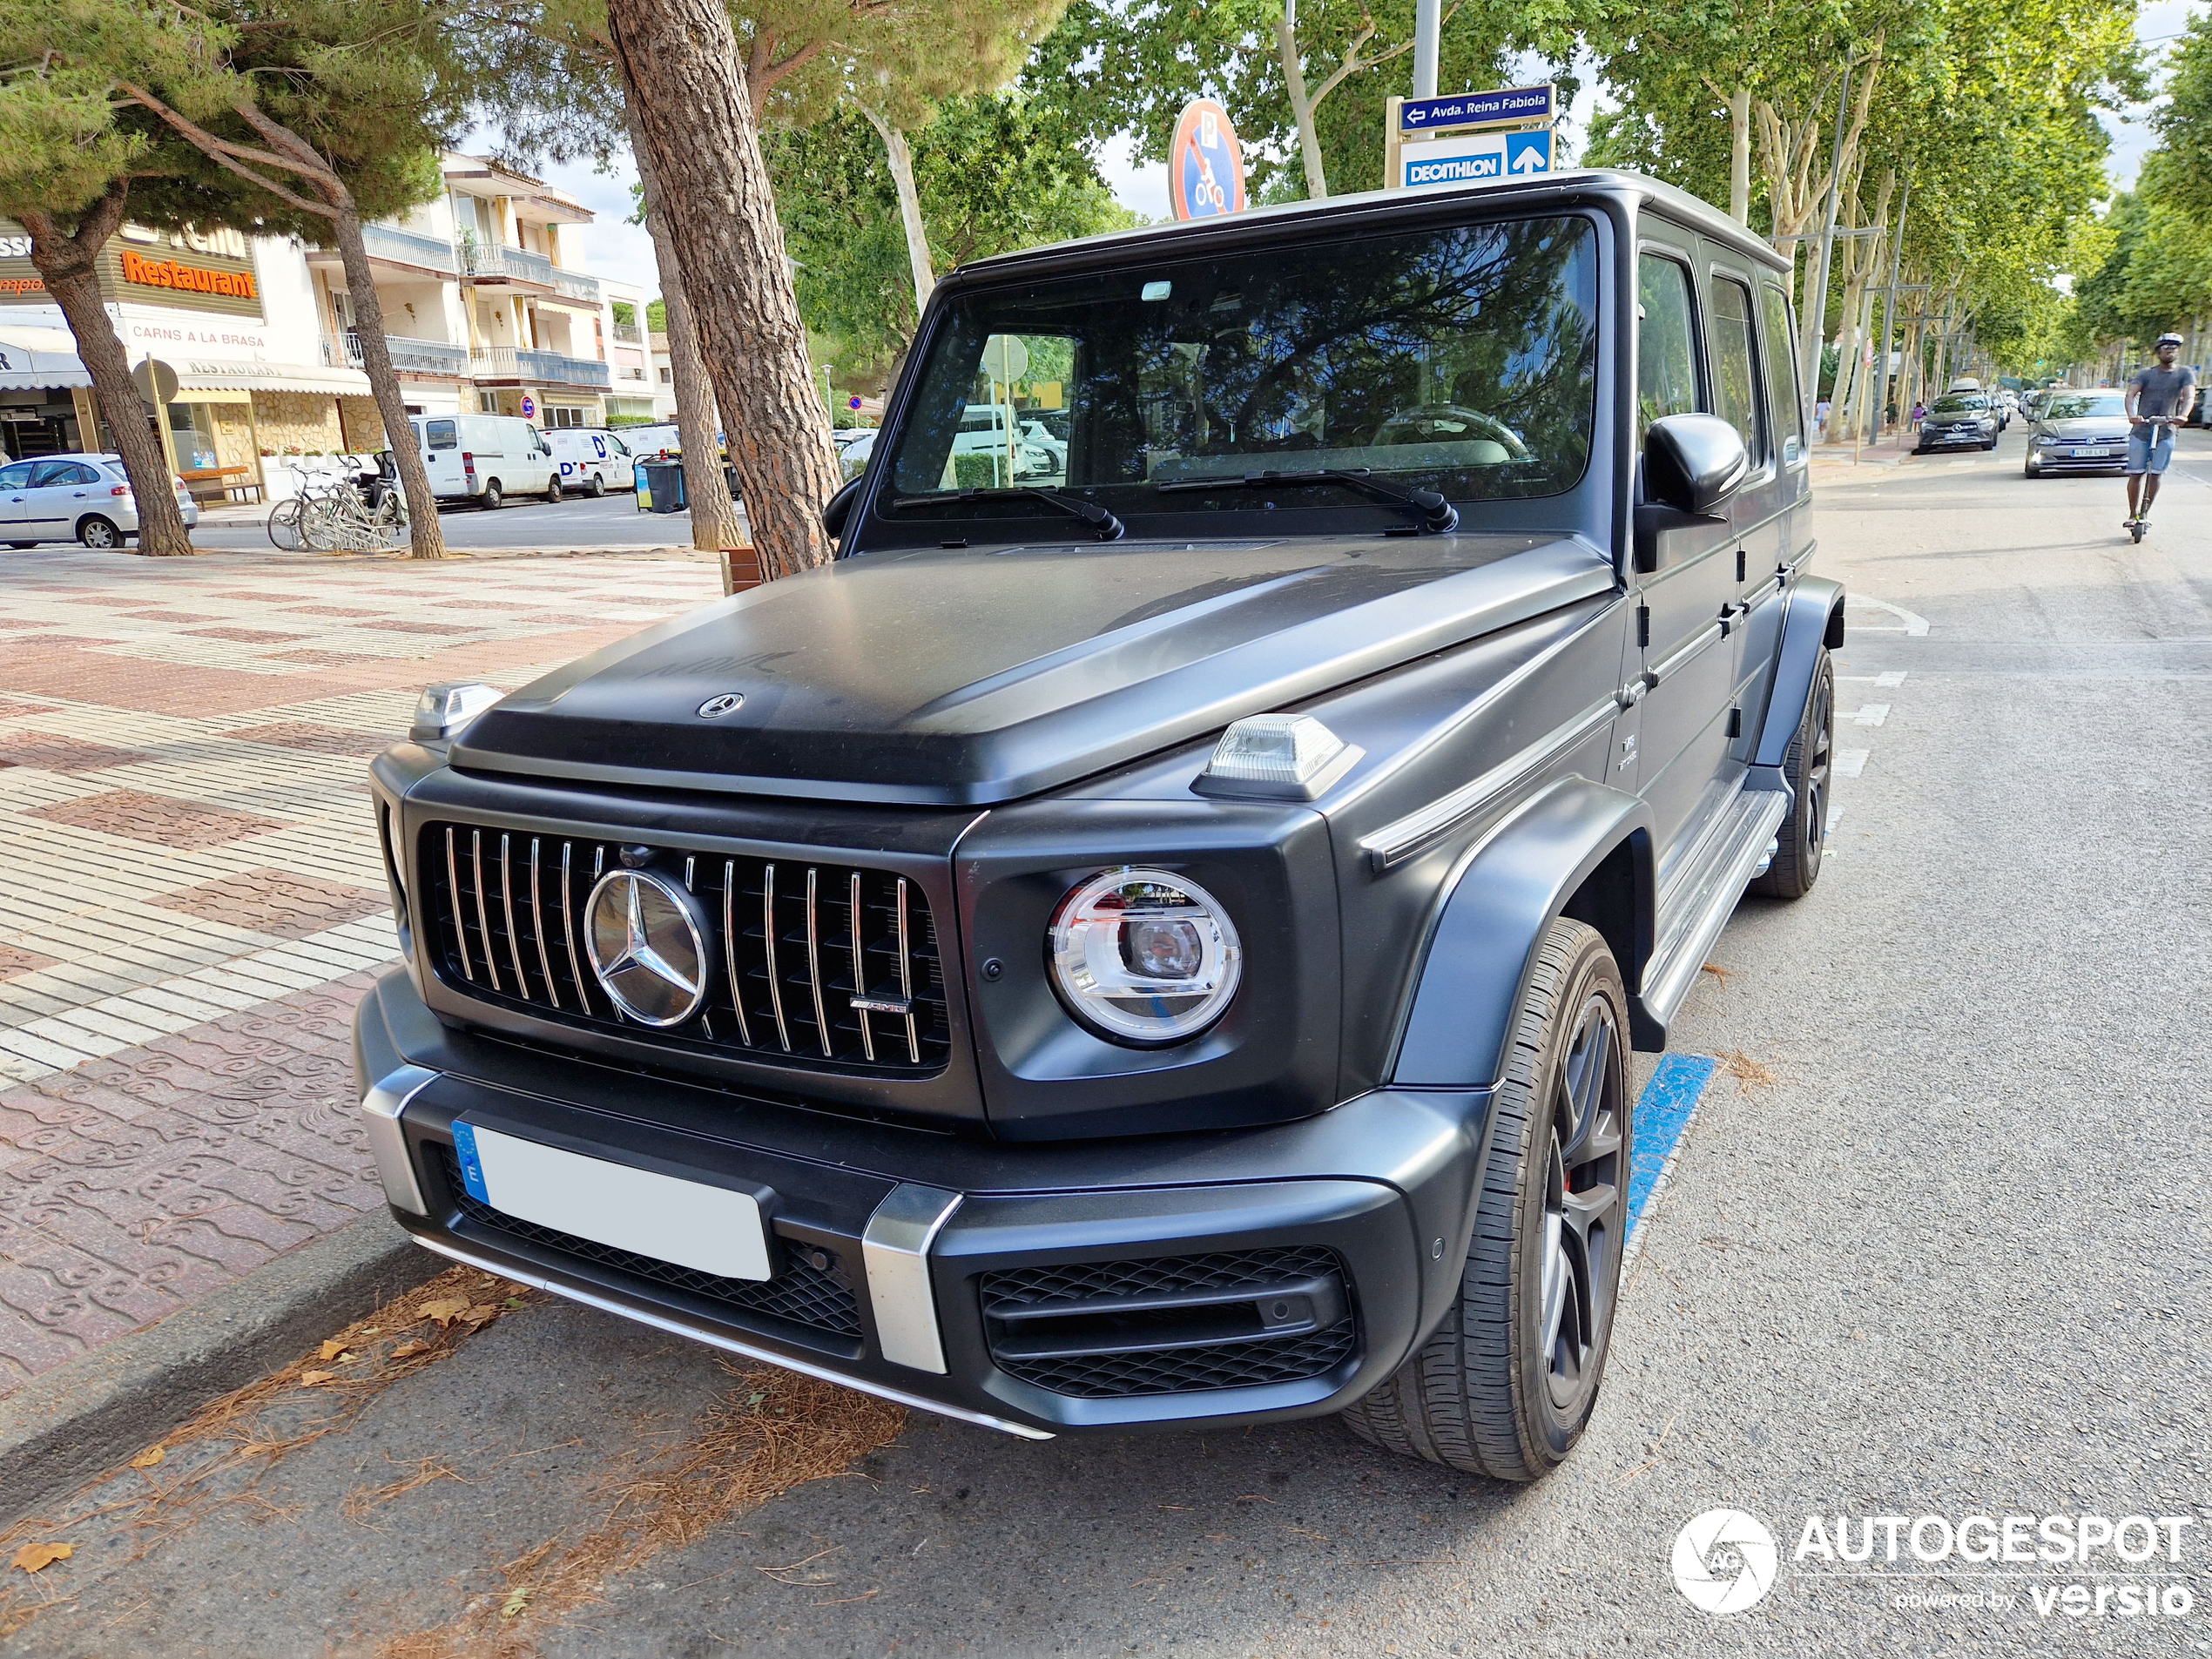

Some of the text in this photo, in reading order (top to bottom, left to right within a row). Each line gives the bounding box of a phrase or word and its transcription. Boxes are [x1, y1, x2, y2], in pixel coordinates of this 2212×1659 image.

[1431, 95, 1546, 118] Avda. Reina Fabiola
[1411, 158, 1497, 182] DECATHLON
[121, 250, 258, 298] Restaurant
[133, 326, 265, 347] CARNS A LA BRASA
[870, 1002, 907, 1013] AMG
